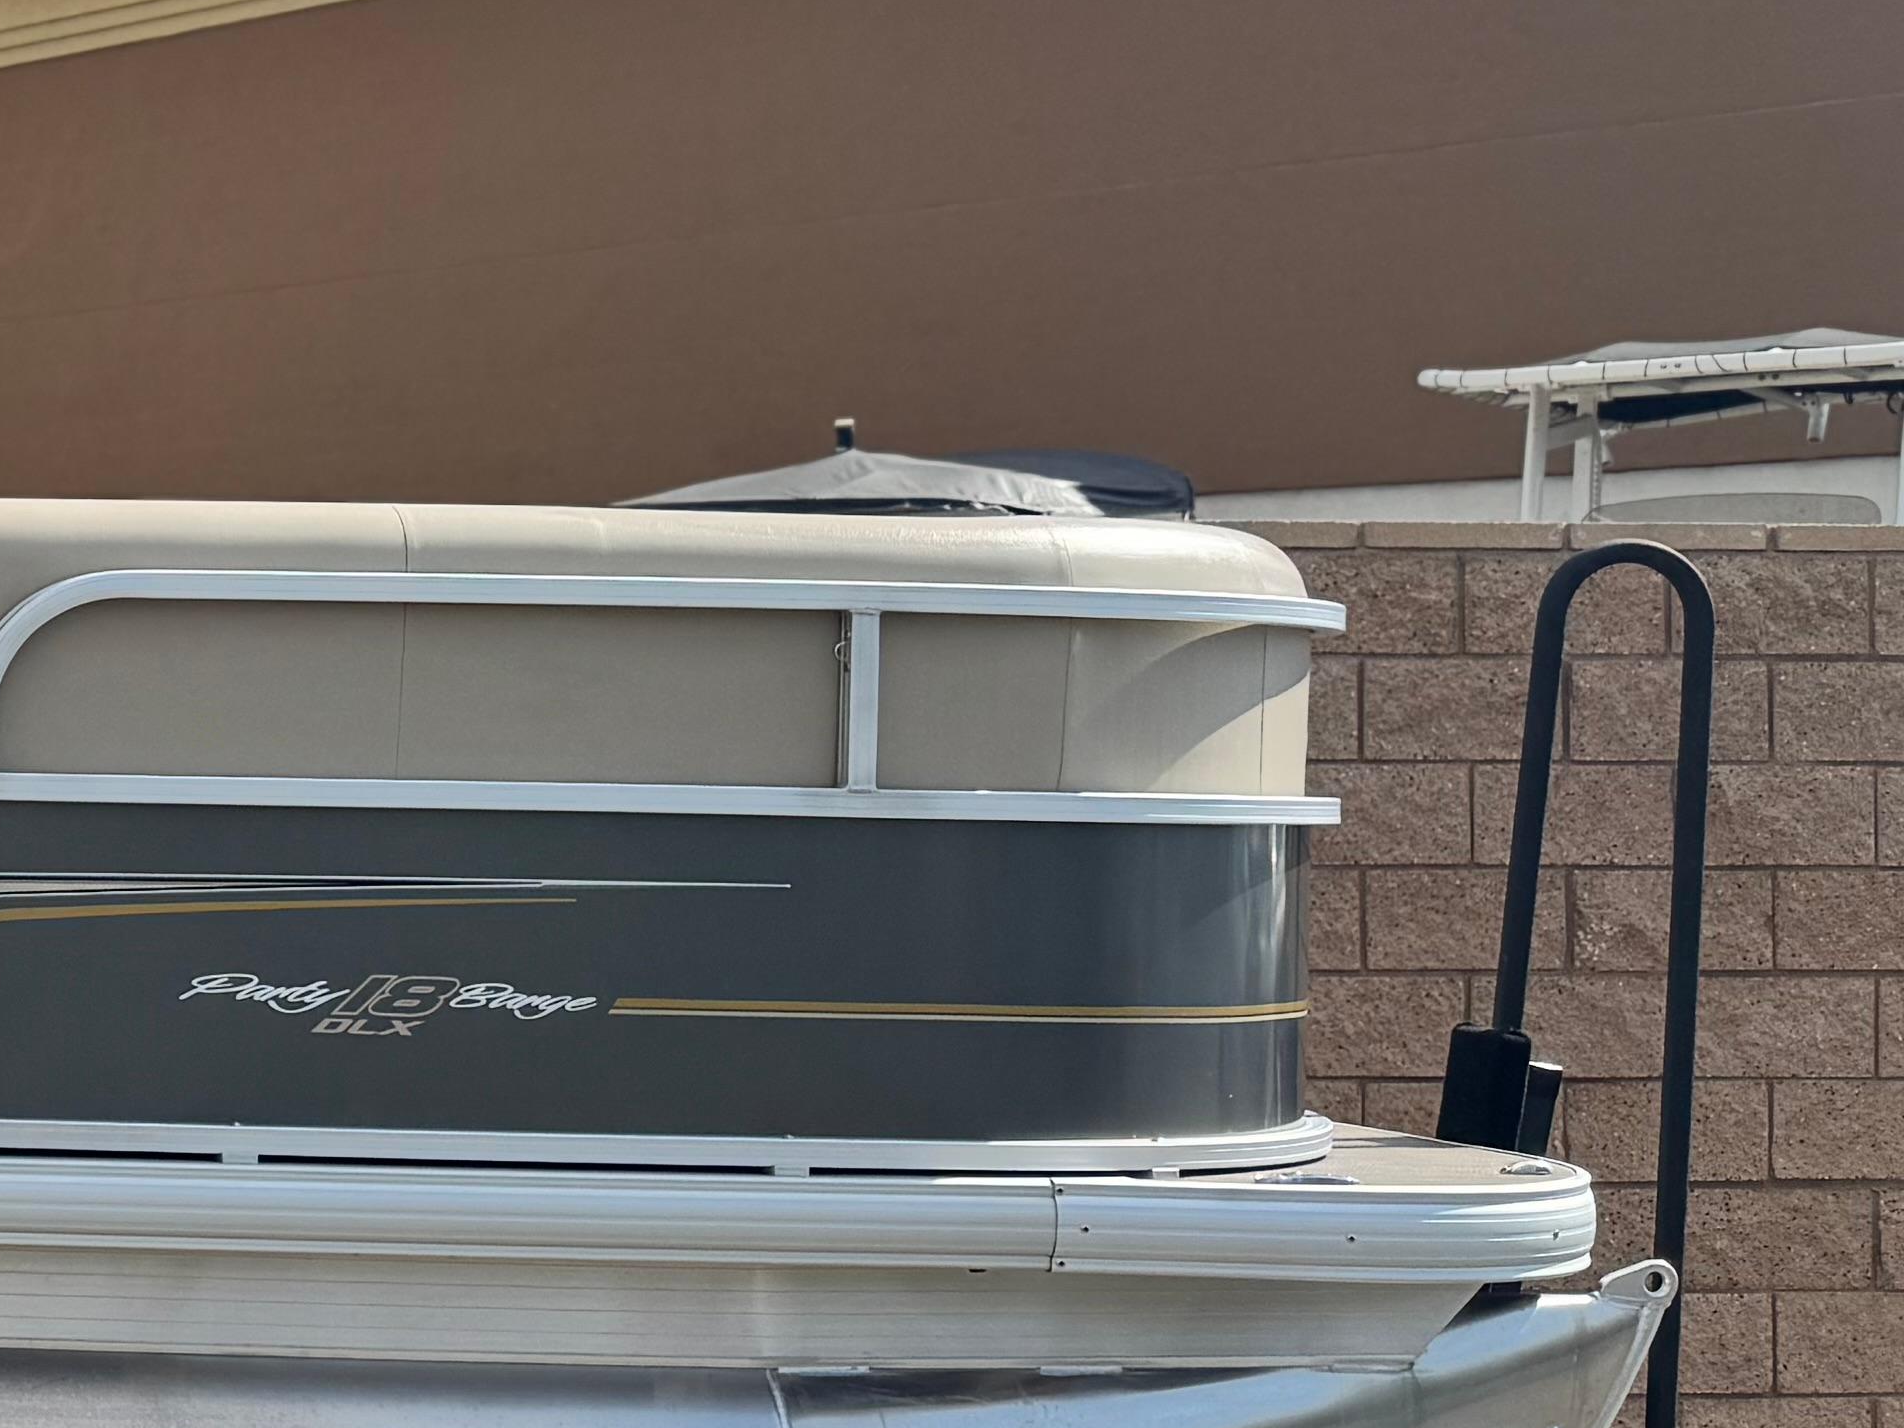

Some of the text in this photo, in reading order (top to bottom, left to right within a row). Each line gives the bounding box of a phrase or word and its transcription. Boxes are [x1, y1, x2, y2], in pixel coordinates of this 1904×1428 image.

[179, 973, 597, 1019] Party 18 Barge
[310, 1018, 425, 1036] DLX
